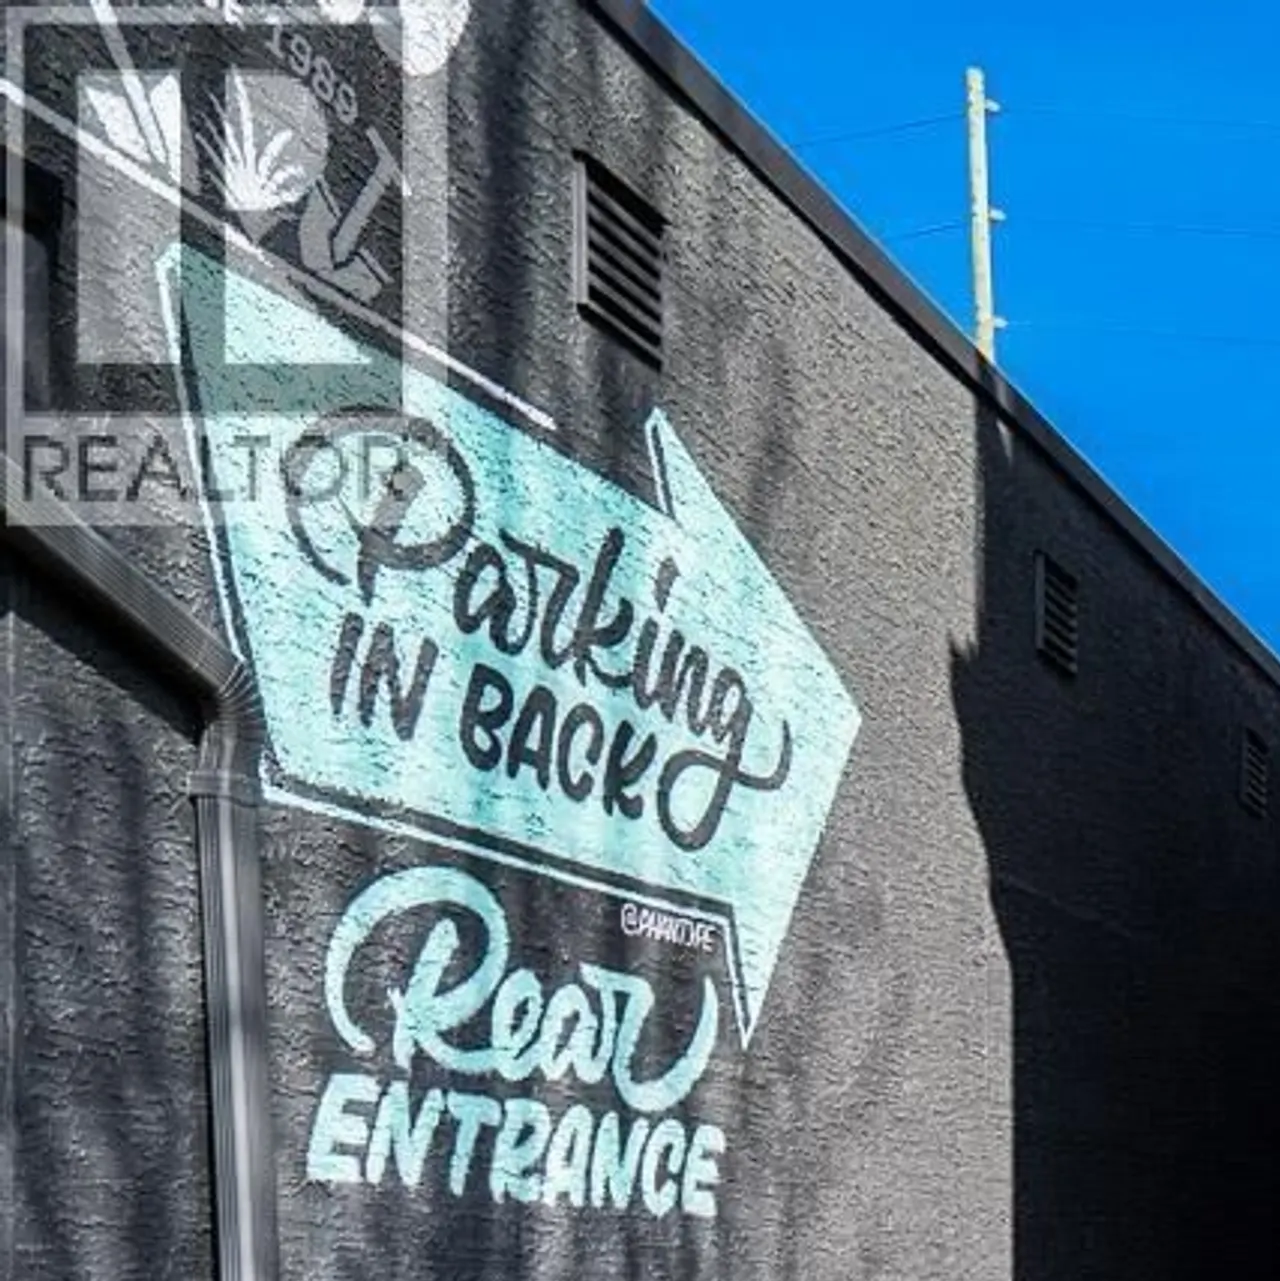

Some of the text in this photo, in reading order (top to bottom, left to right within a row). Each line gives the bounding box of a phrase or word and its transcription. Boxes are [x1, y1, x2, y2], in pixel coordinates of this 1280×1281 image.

[280, 404, 792, 851] Parking
[329, 612, 657, 821] IN BACK
[324, 866, 718, 1112] Rear
[306, 1073, 726, 1217] ENTRANCE
